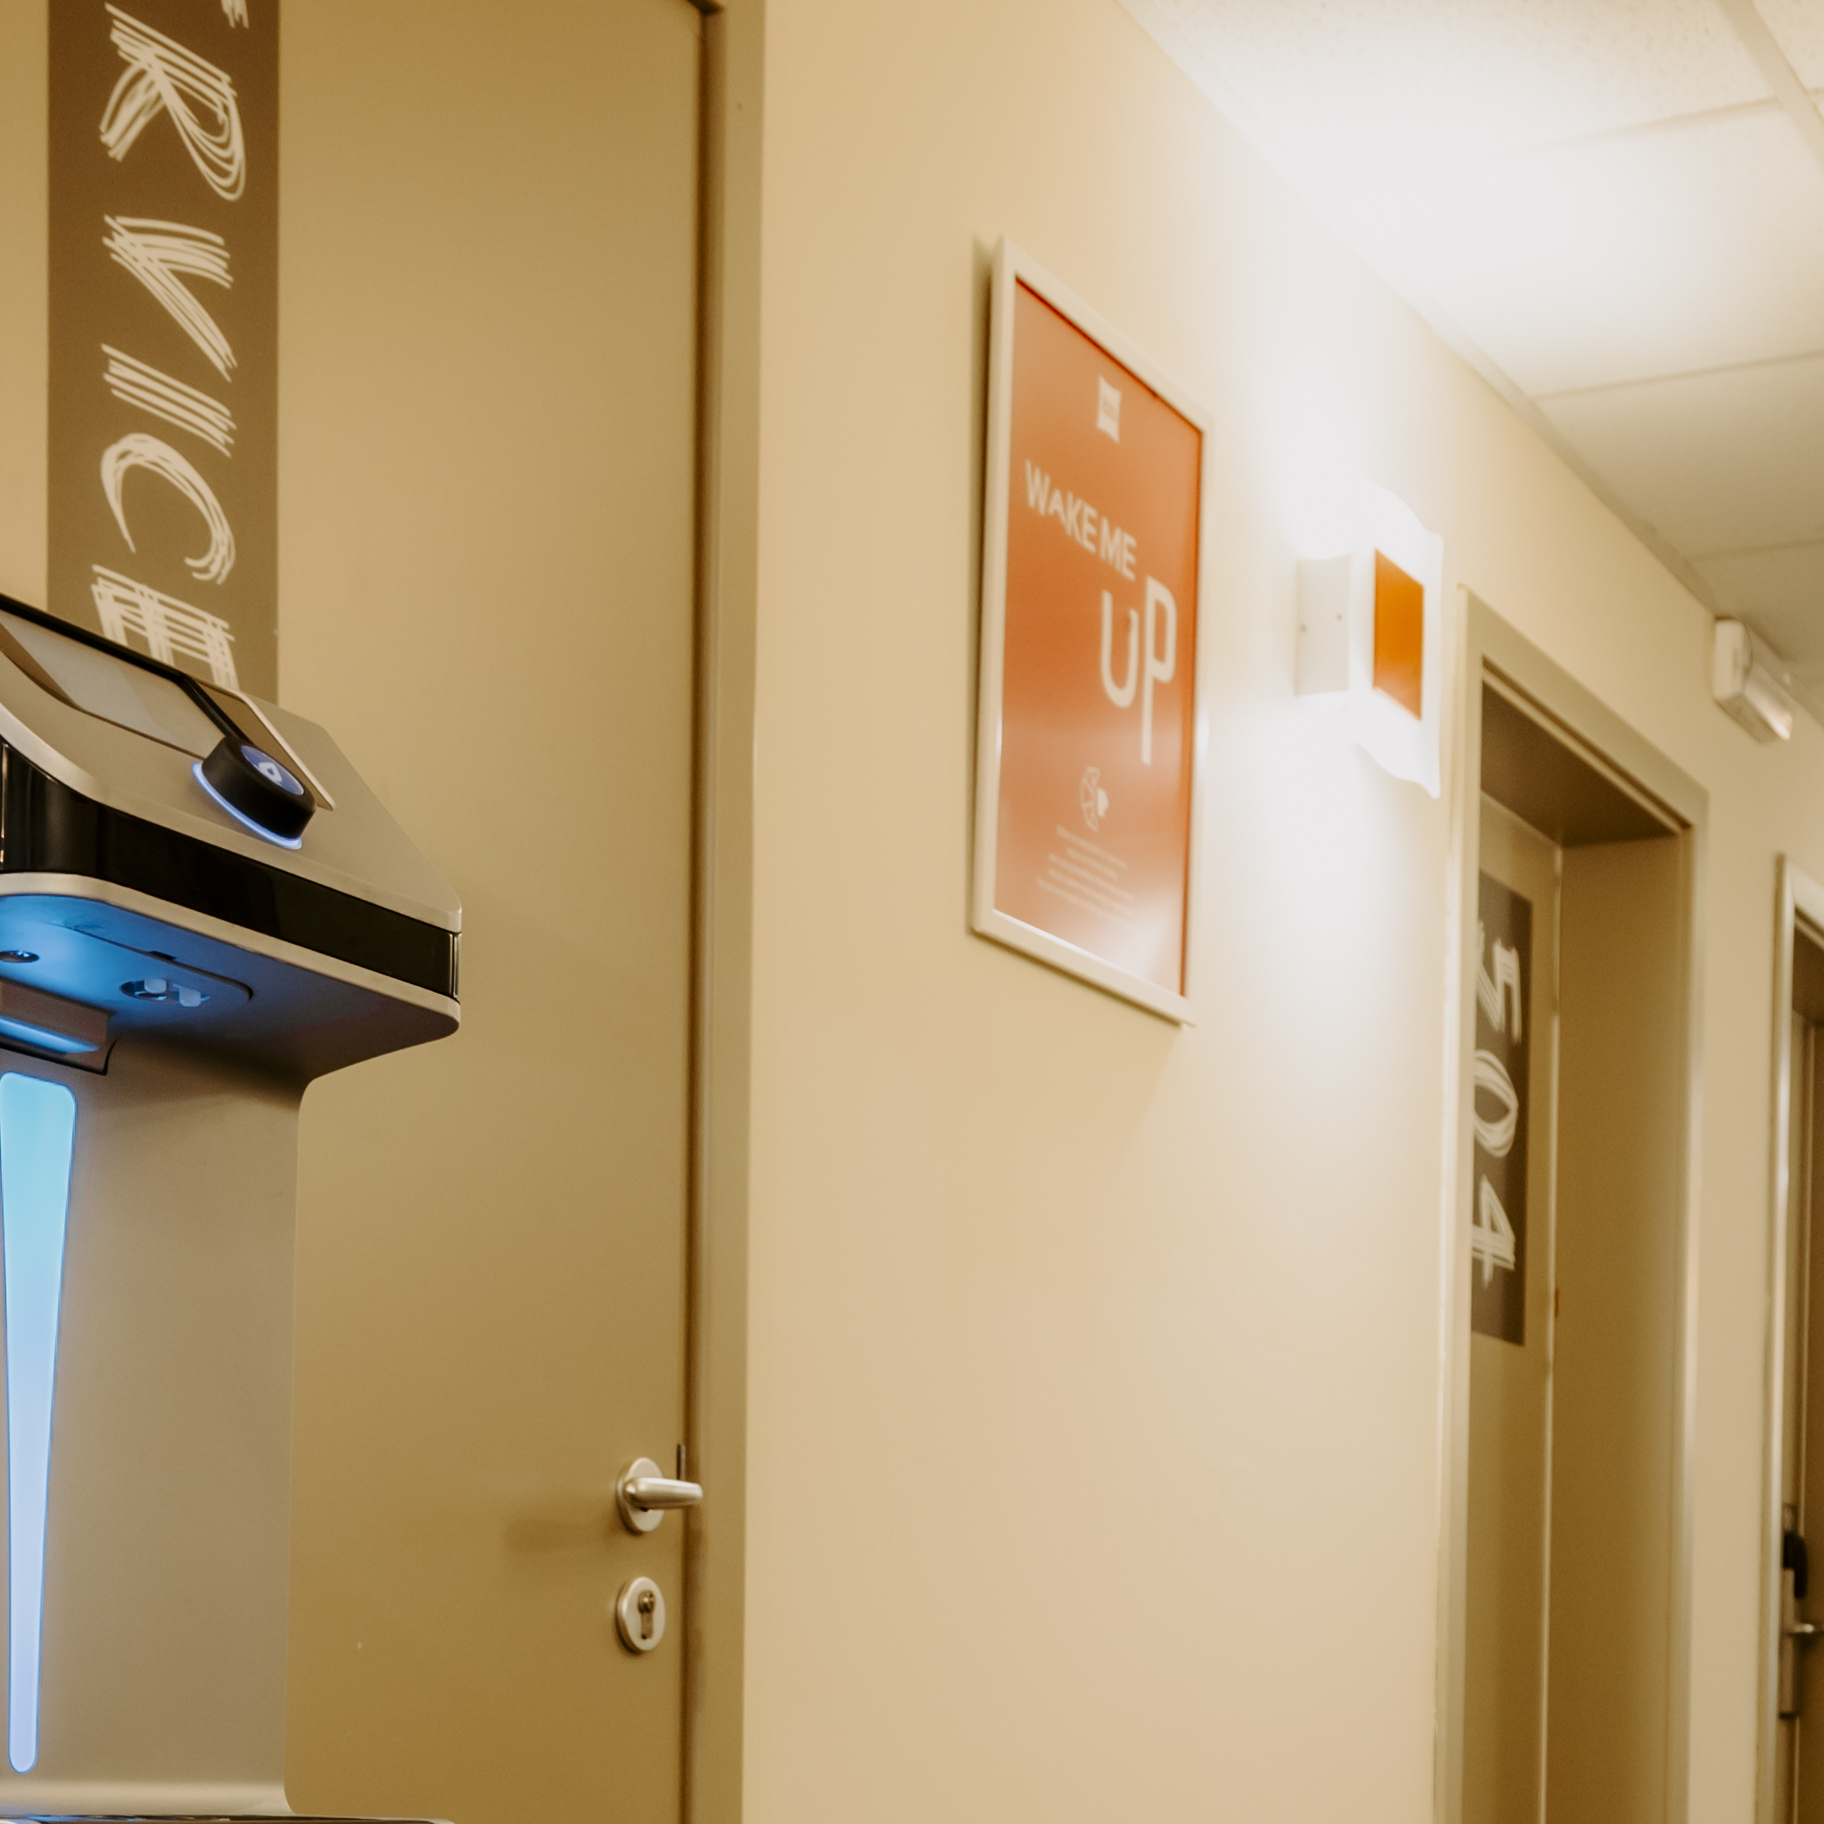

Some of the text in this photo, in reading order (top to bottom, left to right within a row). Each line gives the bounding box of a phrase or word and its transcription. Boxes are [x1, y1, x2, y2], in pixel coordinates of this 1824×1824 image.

[91, 0, 249, 692] RVICE
[1025, 459, 1137, 582] WAKE ME
[1100, 575, 1177, 767] UP
